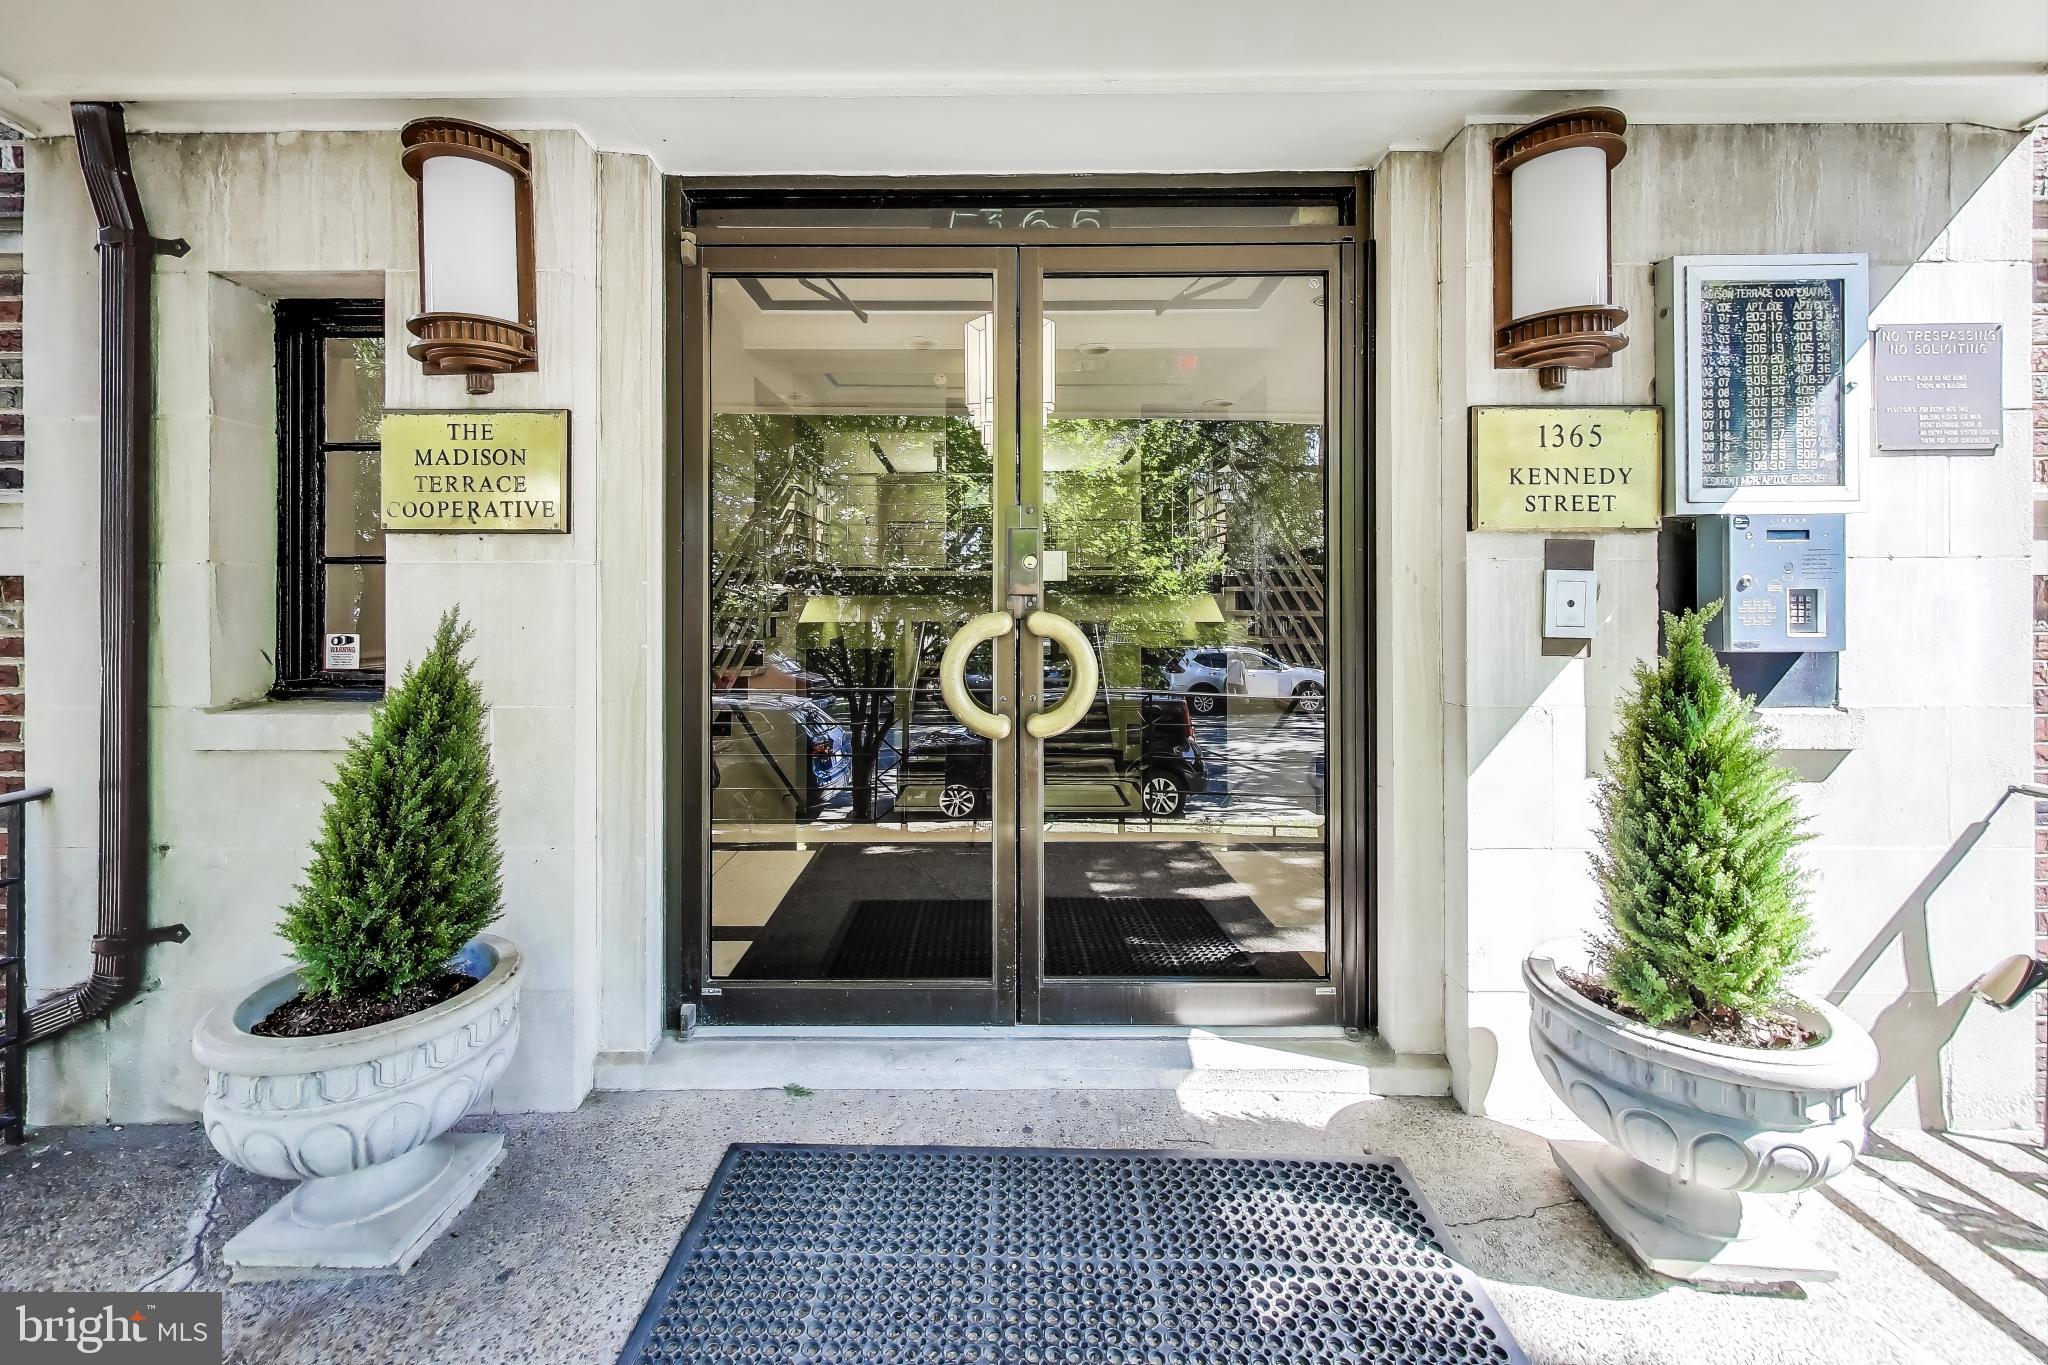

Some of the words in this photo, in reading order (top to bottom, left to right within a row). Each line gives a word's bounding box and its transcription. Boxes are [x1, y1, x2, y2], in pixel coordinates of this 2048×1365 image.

[1746, 312, 1766, 321] 203
[1771, 312, 1783, 321] 16
[1746, 322, 1766, 332] 204
[1772, 322, 1783, 332] 17
[1793, 321, 1812, 330] 403
[1745, 333, 1766, 342] 205
[1772, 333, 1782, 342] 18
[1882, 330, 1900, 342] NO
[1907, 330, 1996, 342] TRESPASSING
[1746, 344, 1767, 353] 206
[1772, 343, 1784, 352] 19
[1890, 344, 1908, 355] NO
[1914, 343, 1988, 355] SOLICITING
[1771, 354, 1784, 363] 20
[1746, 376, 1767, 385] 209
[1772, 376, 1785, 385] 22
[1772, 386, 1785, 395] 23
[1746, 398, 1767, 407] 302
[1719, 410, 1730, 419] 10
[1746, 408, 1766, 417] 303
[447, 424, 494, 440] THE
[1538, 424, 1602, 448] 1365
[414, 449, 527, 466] MADISON
[1746, 450, 1767, 460] 307
[1770, 460, 1785, 470] 30
[1509, 467, 1633, 485] KENNEDY
[414, 476, 527, 493] TERRACE
[1525, 495, 1616, 512] STREET
[386, 501, 556, 518] COOPERATIVE
